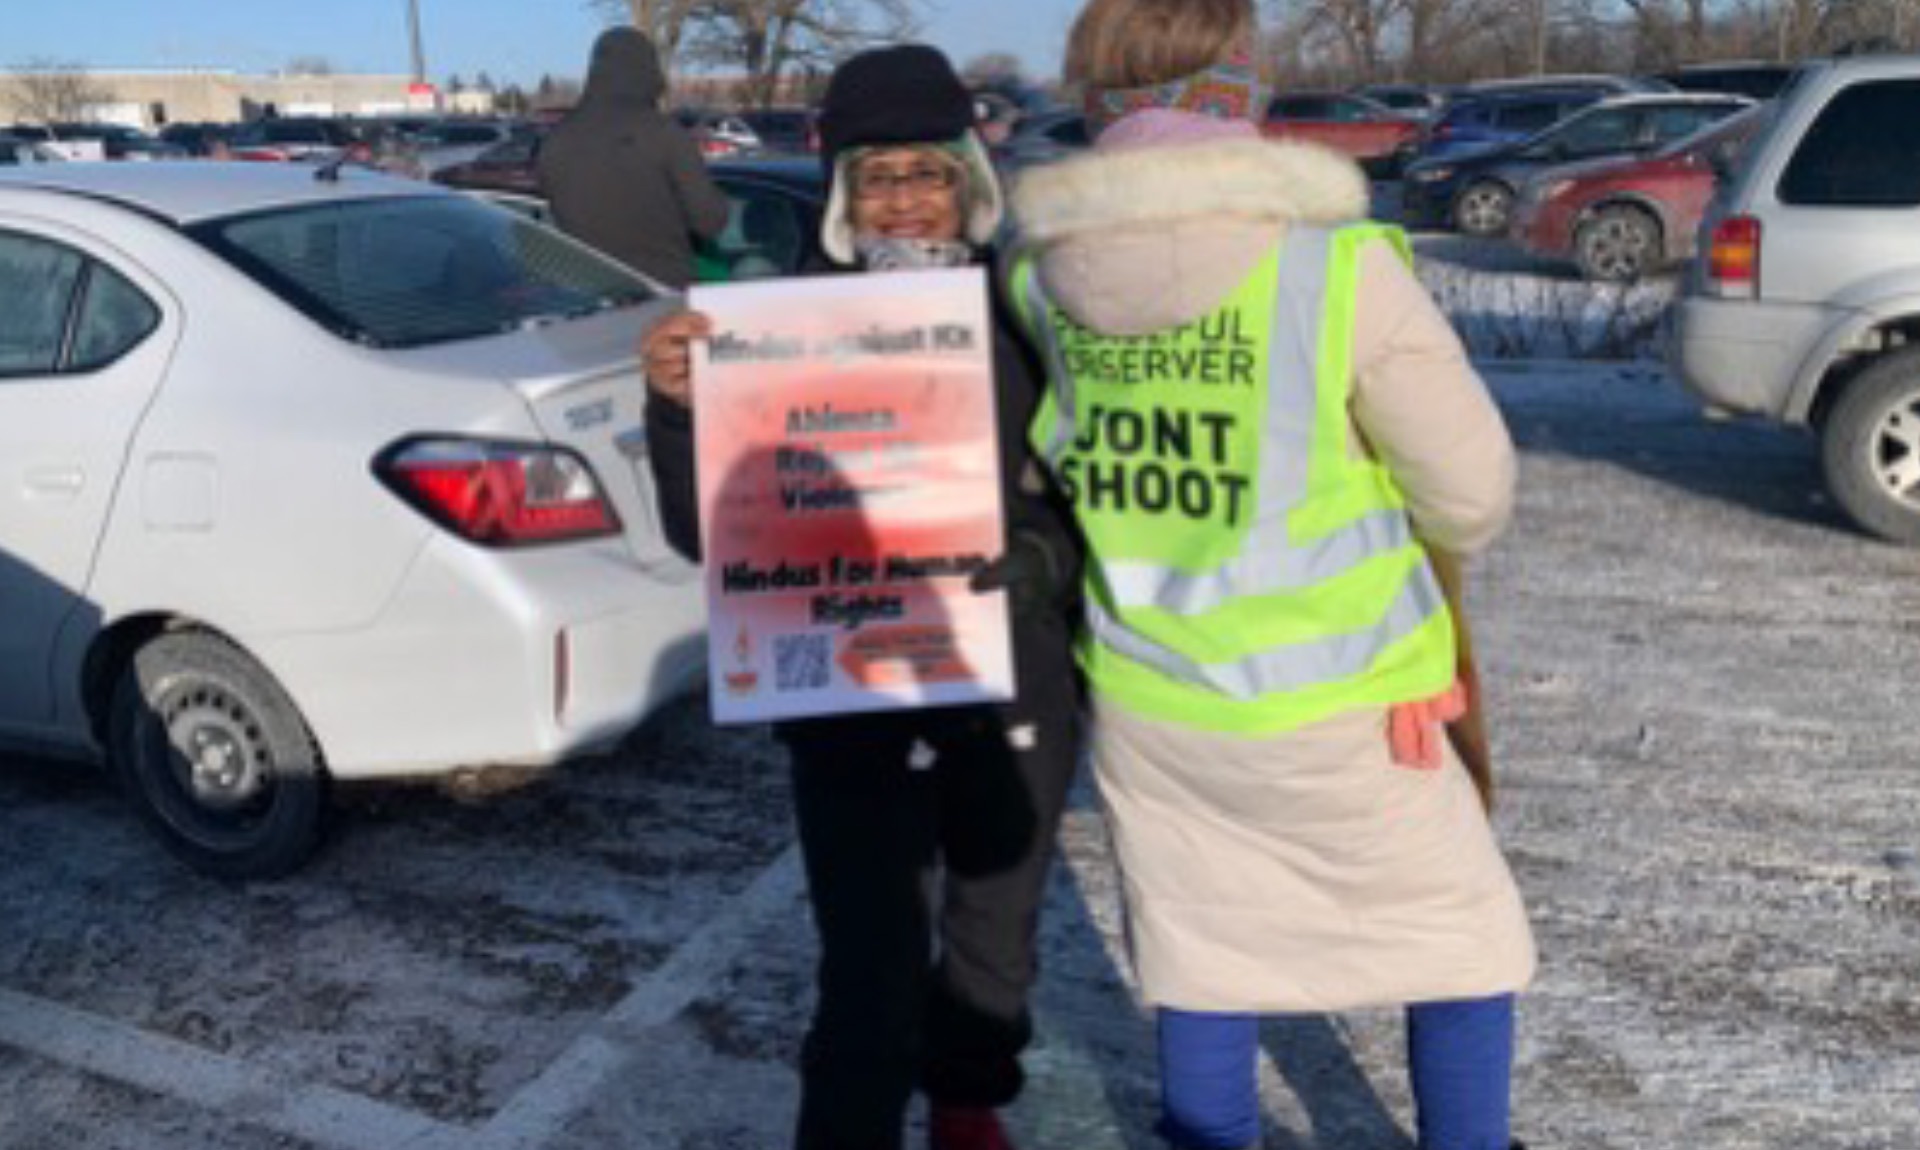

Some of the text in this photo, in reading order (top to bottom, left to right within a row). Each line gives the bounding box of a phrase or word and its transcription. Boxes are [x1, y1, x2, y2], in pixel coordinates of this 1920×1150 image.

[1058, 454, 1249, 528] SHOOT
[722, 558, 821, 593] Hindus
[829, 553, 877, 584] for
